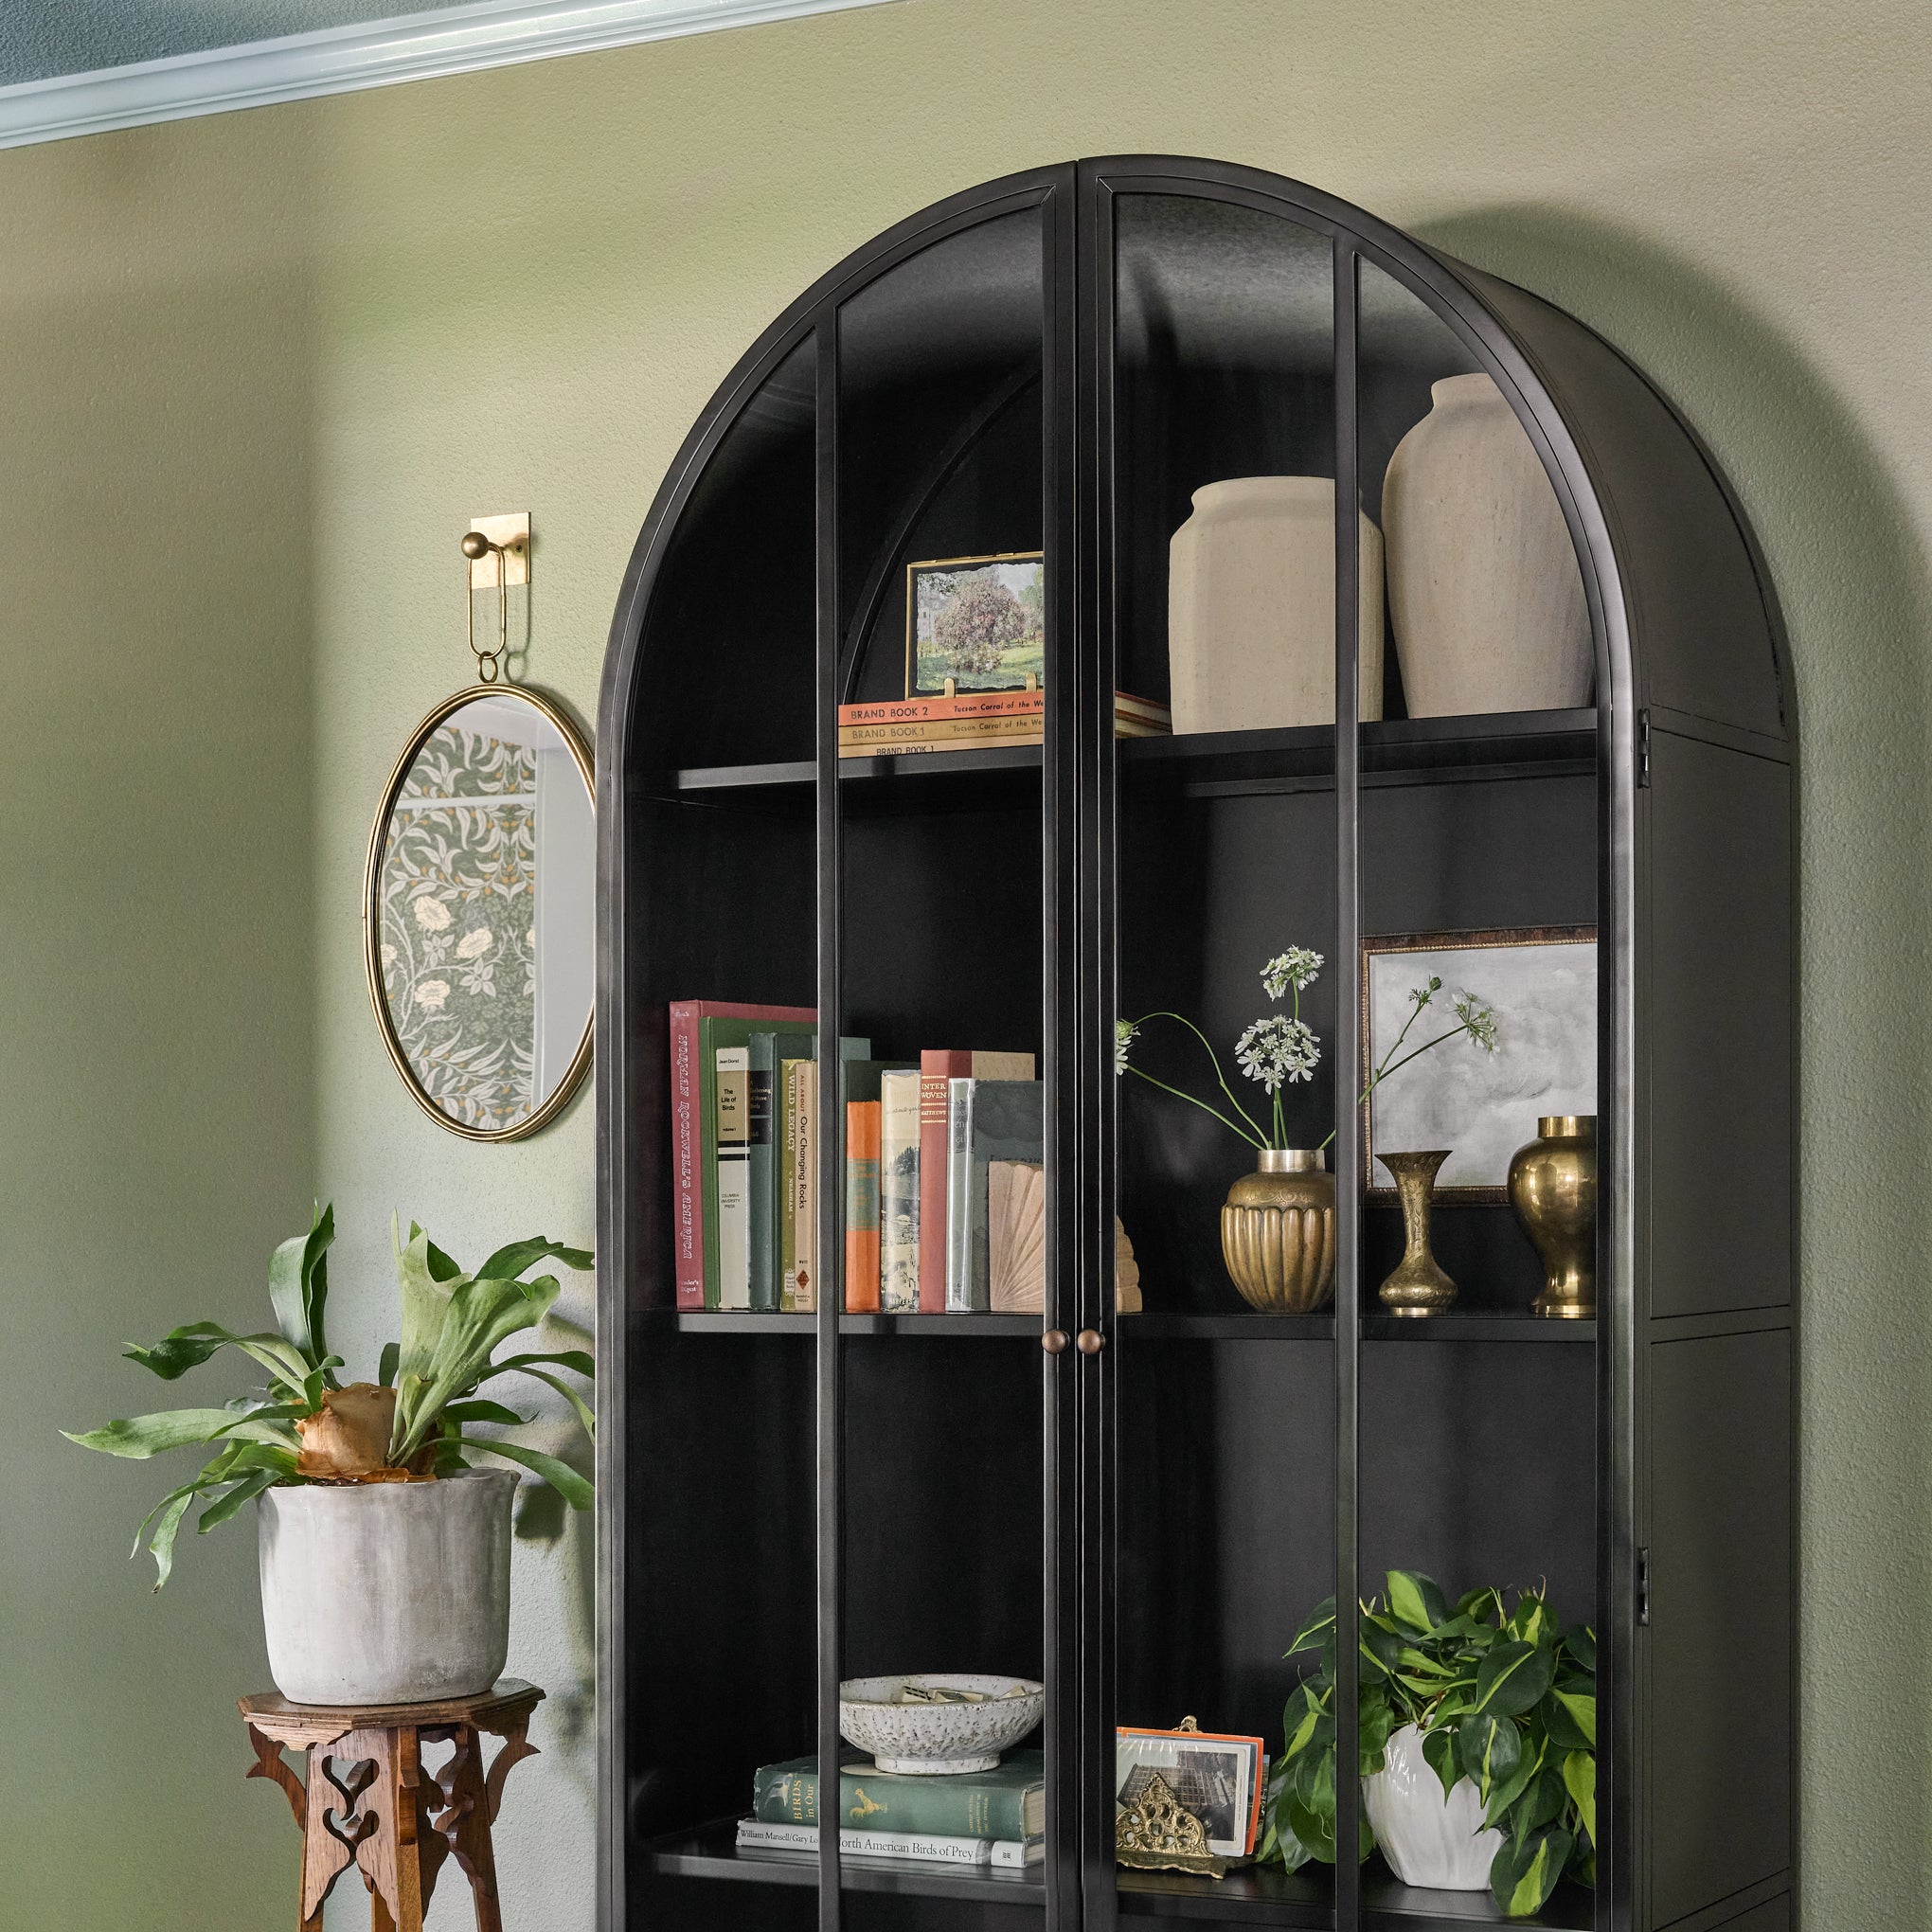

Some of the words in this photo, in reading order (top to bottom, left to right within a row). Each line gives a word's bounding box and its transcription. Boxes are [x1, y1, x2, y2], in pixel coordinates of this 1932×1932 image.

[850, 709, 886, 720] BRAND
[890, 707, 918, 717] BOOK
[922, 707, 928, 716] 2
[980, 703, 1004, 711] Corral
[852, 729, 886, 740] BRAND
[890, 727, 918, 737] BOOK
[921, 727, 924, 736] 1
[876, 747, 903, 756] BRAND
[905, 745, 926, 755] BOOK
[676, 1034, 689, 1097] NORMAN
[787, 1109, 796, 1152] LEGACY
[678, 1100, 691, 1189] ROCKWELL'S
[797, 1137, 808, 1181] Changing
[798, 1184, 807, 1209] Rocks
[679, 1192, 692, 1260] AMERICA
[793, 1780, 803, 1820] BIRDS
[806, 1784, 814, 1805] Our
[806, 1809, 814, 1818] in
[741, 1829, 764, 1839] William
[839, 1837, 862, 1849] orth
[864, 1838, 909, 1853] American
[912, 1842, 937, 1856] Birds
[939, 1844, 951, 1856] of
[951, 1846, 974, 1861] Prey
